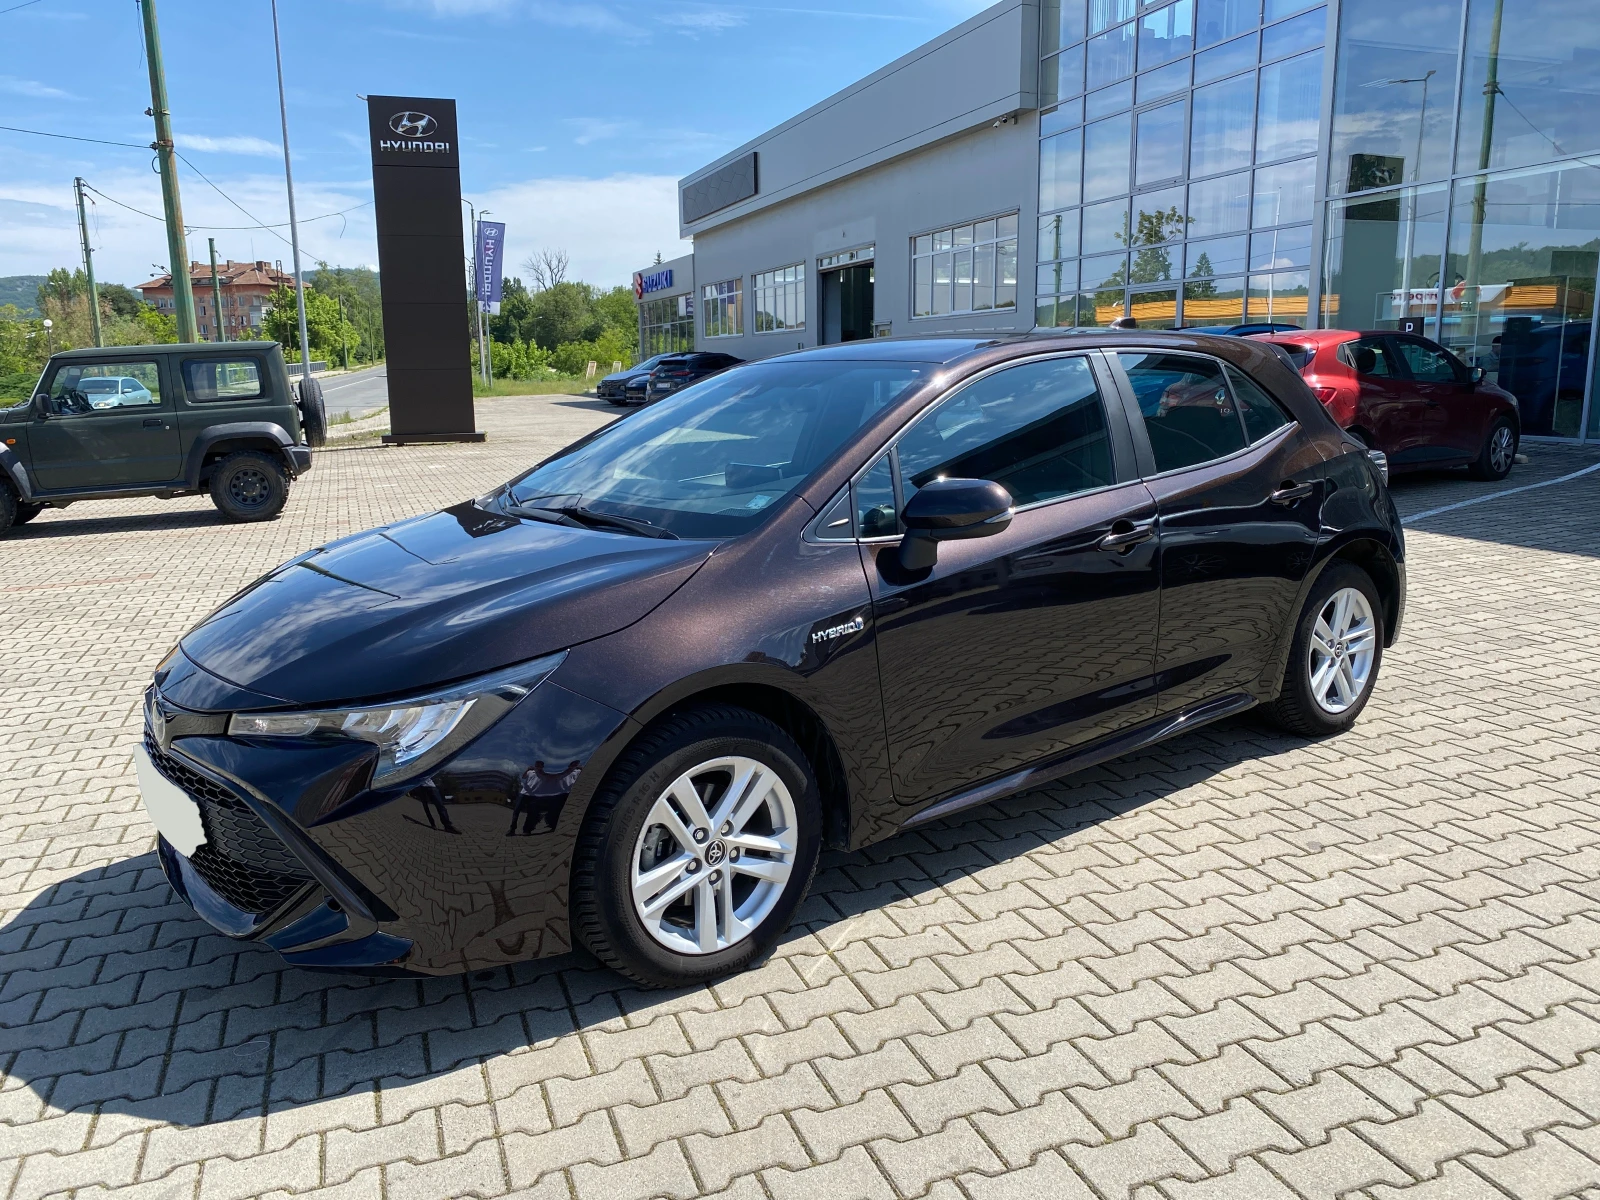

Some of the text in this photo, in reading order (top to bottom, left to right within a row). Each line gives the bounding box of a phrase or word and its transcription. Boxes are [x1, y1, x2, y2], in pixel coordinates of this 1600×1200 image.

[380, 140, 450, 154] HYUNDAI
[484, 239, 495, 295] HYUNDAI
[643, 269, 672, 293] SUZUKI
[1406, 322, 1414, 332] P
[812, 621, 856, 644] HYBRID
